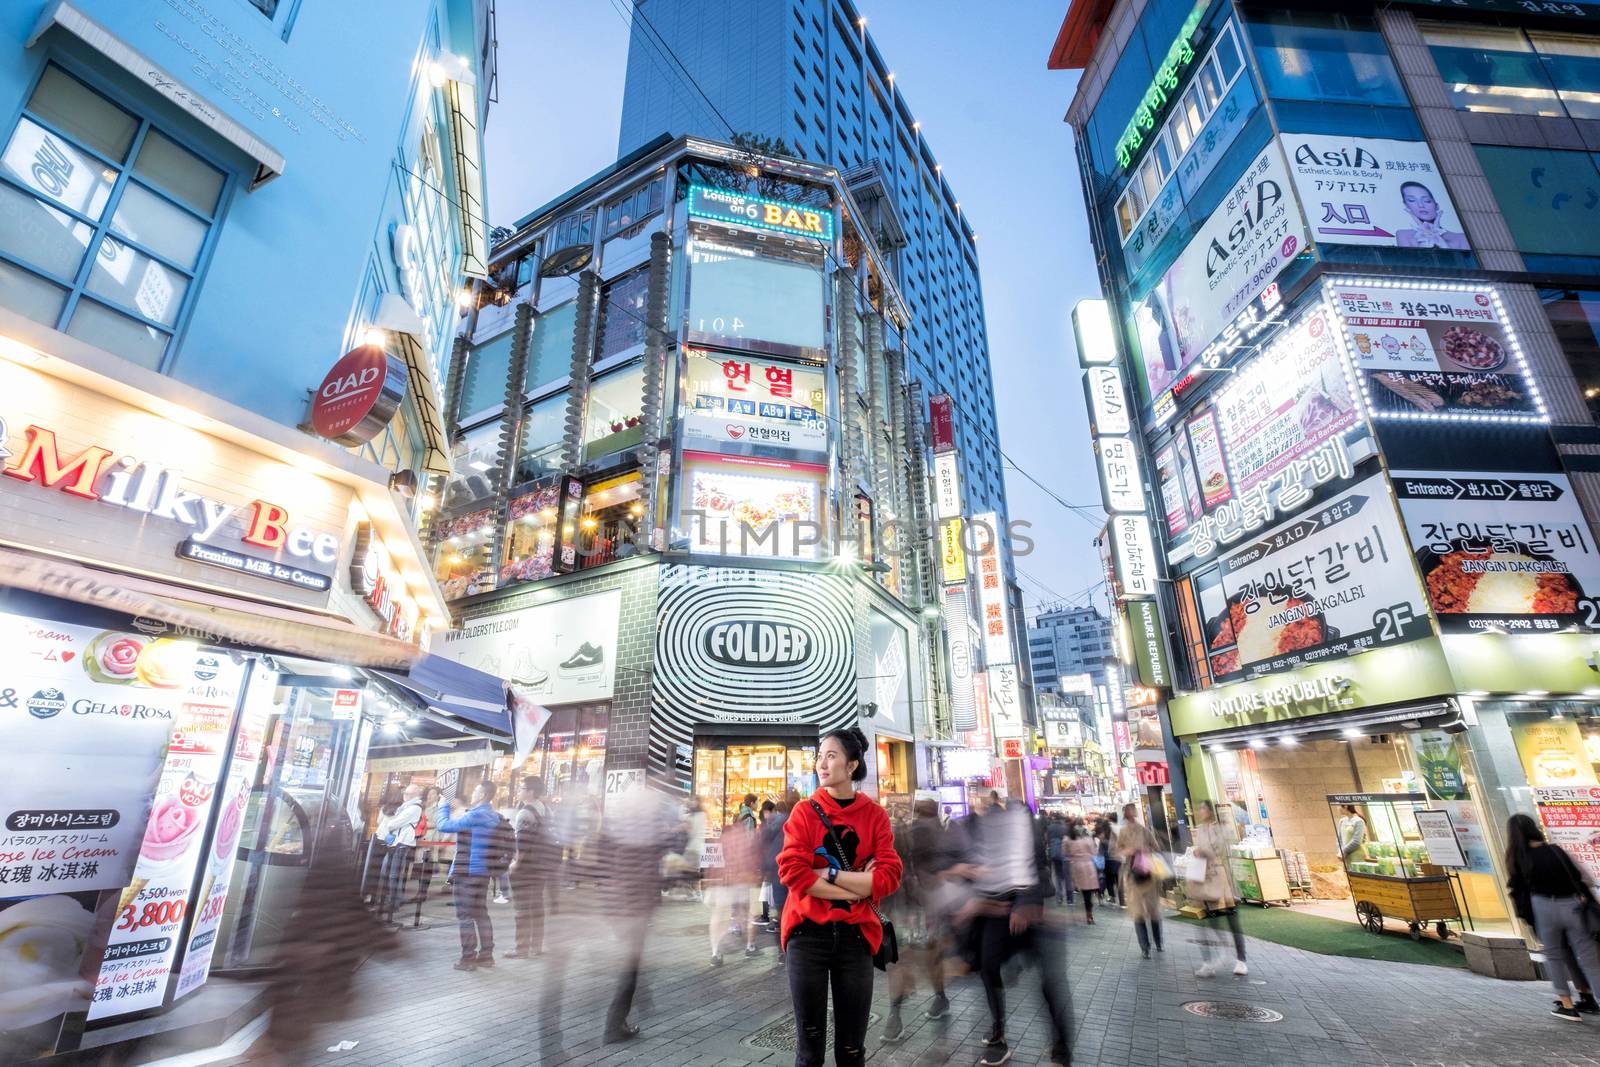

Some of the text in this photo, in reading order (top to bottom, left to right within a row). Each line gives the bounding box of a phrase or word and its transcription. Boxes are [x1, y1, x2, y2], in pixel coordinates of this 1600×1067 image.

[271, 106, 282, 118] &
[1116, 37, 1197, 169] 김선영미용실
[1298, 167, 1383, 180] Esthetic Skin & Body
[1384, 159, 1433, 174] 皮肤护理
[1225, 154, 1271, 217] 皮肤护理
[1314, 180, 1377, 194] アジアエステ
[702, 187, 746, 206] Lounge
[729, 203, 823, 234] on 6 BAR
[1321, 202, 1371, 225] 入口
[1208, 203, 1286, 291] Esthetic Skin & Body
[1283, 238, 1297, 255] 4F
[1399, 302, 1454, 318] 참숯구이
[1363, 318, 1379, 326] YOU
[1380, 318, 1397, 327] CAN
[1398, 319, 1414, 327] EAT
[1410, 355, 1434, 363] Chicken
[721, 359, 794, 399] 헌혈
[748, 425, 791, 442] 헌혈의집
[1294, 432, 1317, 454] Grilled
[2, 424, 340, 562] Milky Bee
[1189, 433, 1351, 558] 장인닭갈비
[1406, 482, 1455, 495] Entrance
[1467, 484, 1505, 497] 出入口
[1518, 483, 1555, 498] 출입구
[1321, 500, 1354, 526] 출입구
[1274, 527, 1305, 548] 出入口
[1421, 521, 1589, 556] 장인닭갈비
[1121, 518, 1147, 592] 장인닭갈비
[1229, 548, 1261, 570] Entrance
[189, 543, 325, 589] Premium Milk Ice Cream
[1238, 524, 1389, 616] 장인닭갈비
[1509, 560, 1571, 574] DAKGALBI
[1305, 584, 1367, 616] DAKGALBI
[1375, 603, 1415, 642] 2F
[1577, 599, 1600, 630] 2
[174, 617, 225, 645] Milky
[445, 618, 519, 642] WWW.FOLDERSTYLE.COM
[710, 622, 808, 663] FOLDER
[1140, 602, 1164, 685] NATURE REPUBLIC
[0, 688, 19, 709] &
[1209, 675, 1343, 718] NATURE REPUBLIC
[71, 698, 119, 716] GELA
[131, 702, 172, 720] ROSA
[713, 712, 803, 723] SHOES LIFESTYLE STORE
[756, 755, 795, 771] FILA
[607, 773, 623, 794] 2F
[14, 811, 114, 829] 장미아이스크림
[2, 833, 109, 847] バラのアイスクリーム
[31, 847, 56, 861] Ice
[61, 846, 120, 860] Cream
[37, 860, 99, 882] 冰淇淋
[137, 886, 168, 901] 5,500
[116, 899, 188, 933] 3,800
[160, 923, 179, 933] won
[112, 966, 170, 984] Ice Cream
[116, 978, 158, 998] 冰淇淋
